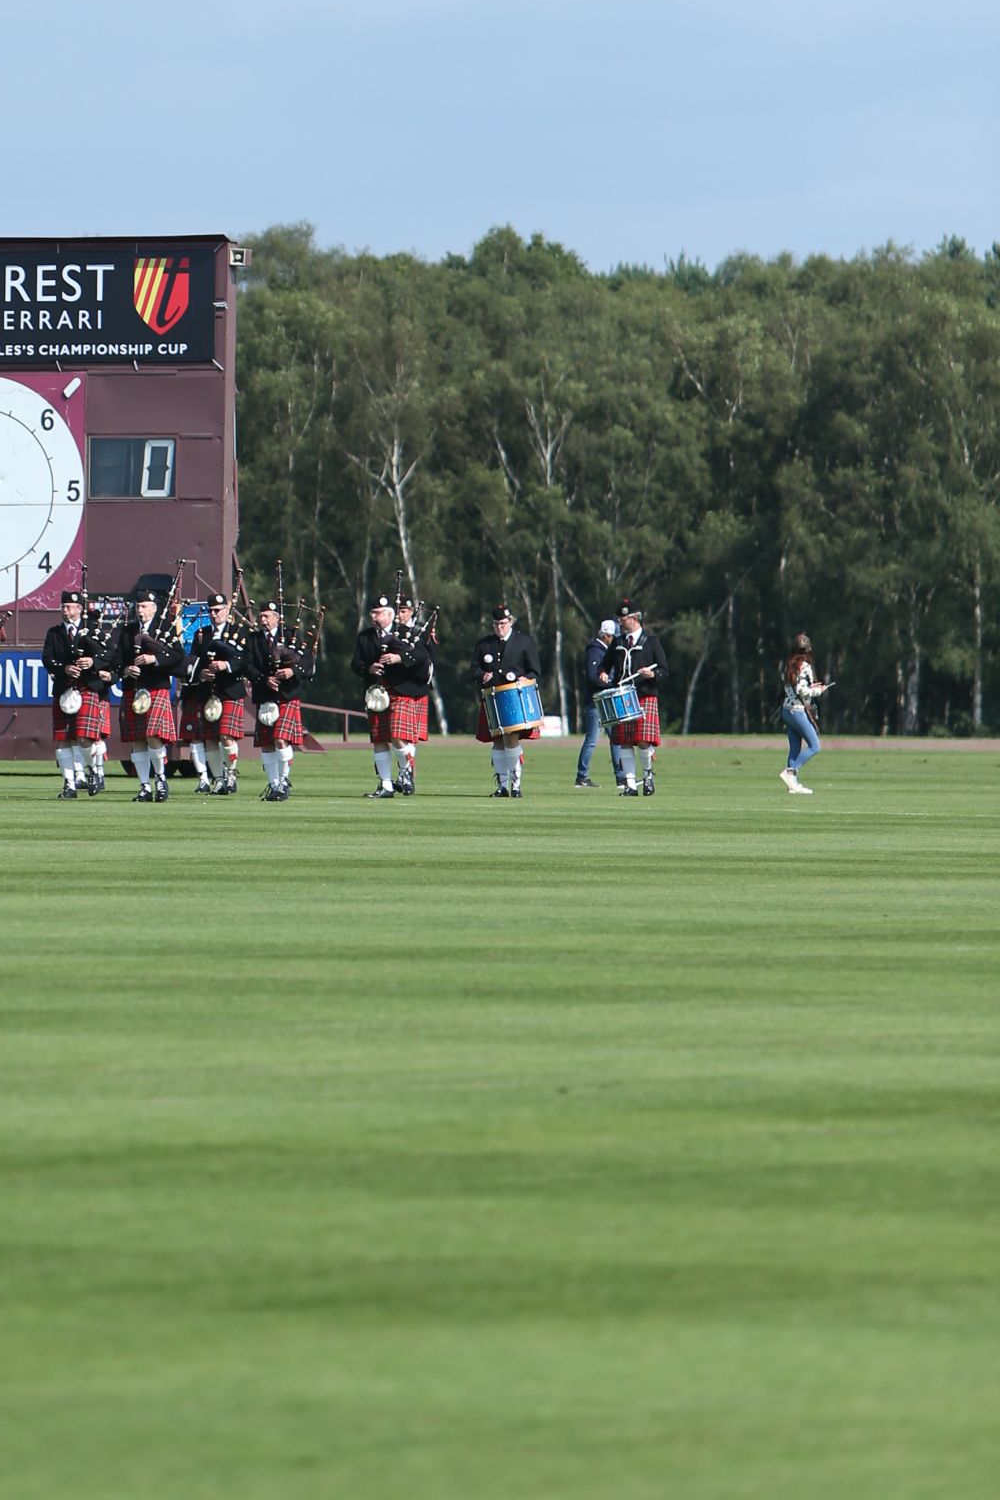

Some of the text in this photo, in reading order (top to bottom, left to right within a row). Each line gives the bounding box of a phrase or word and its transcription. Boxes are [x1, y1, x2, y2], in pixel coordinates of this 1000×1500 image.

[38, 343, 153, 356] CHAMPIONSHIP
[157, 343, 188, 355] CUP
[40, 408, 55, 431] 6
[66, 480, 81, 502] 5
[37, 551, 52, 574] 4
